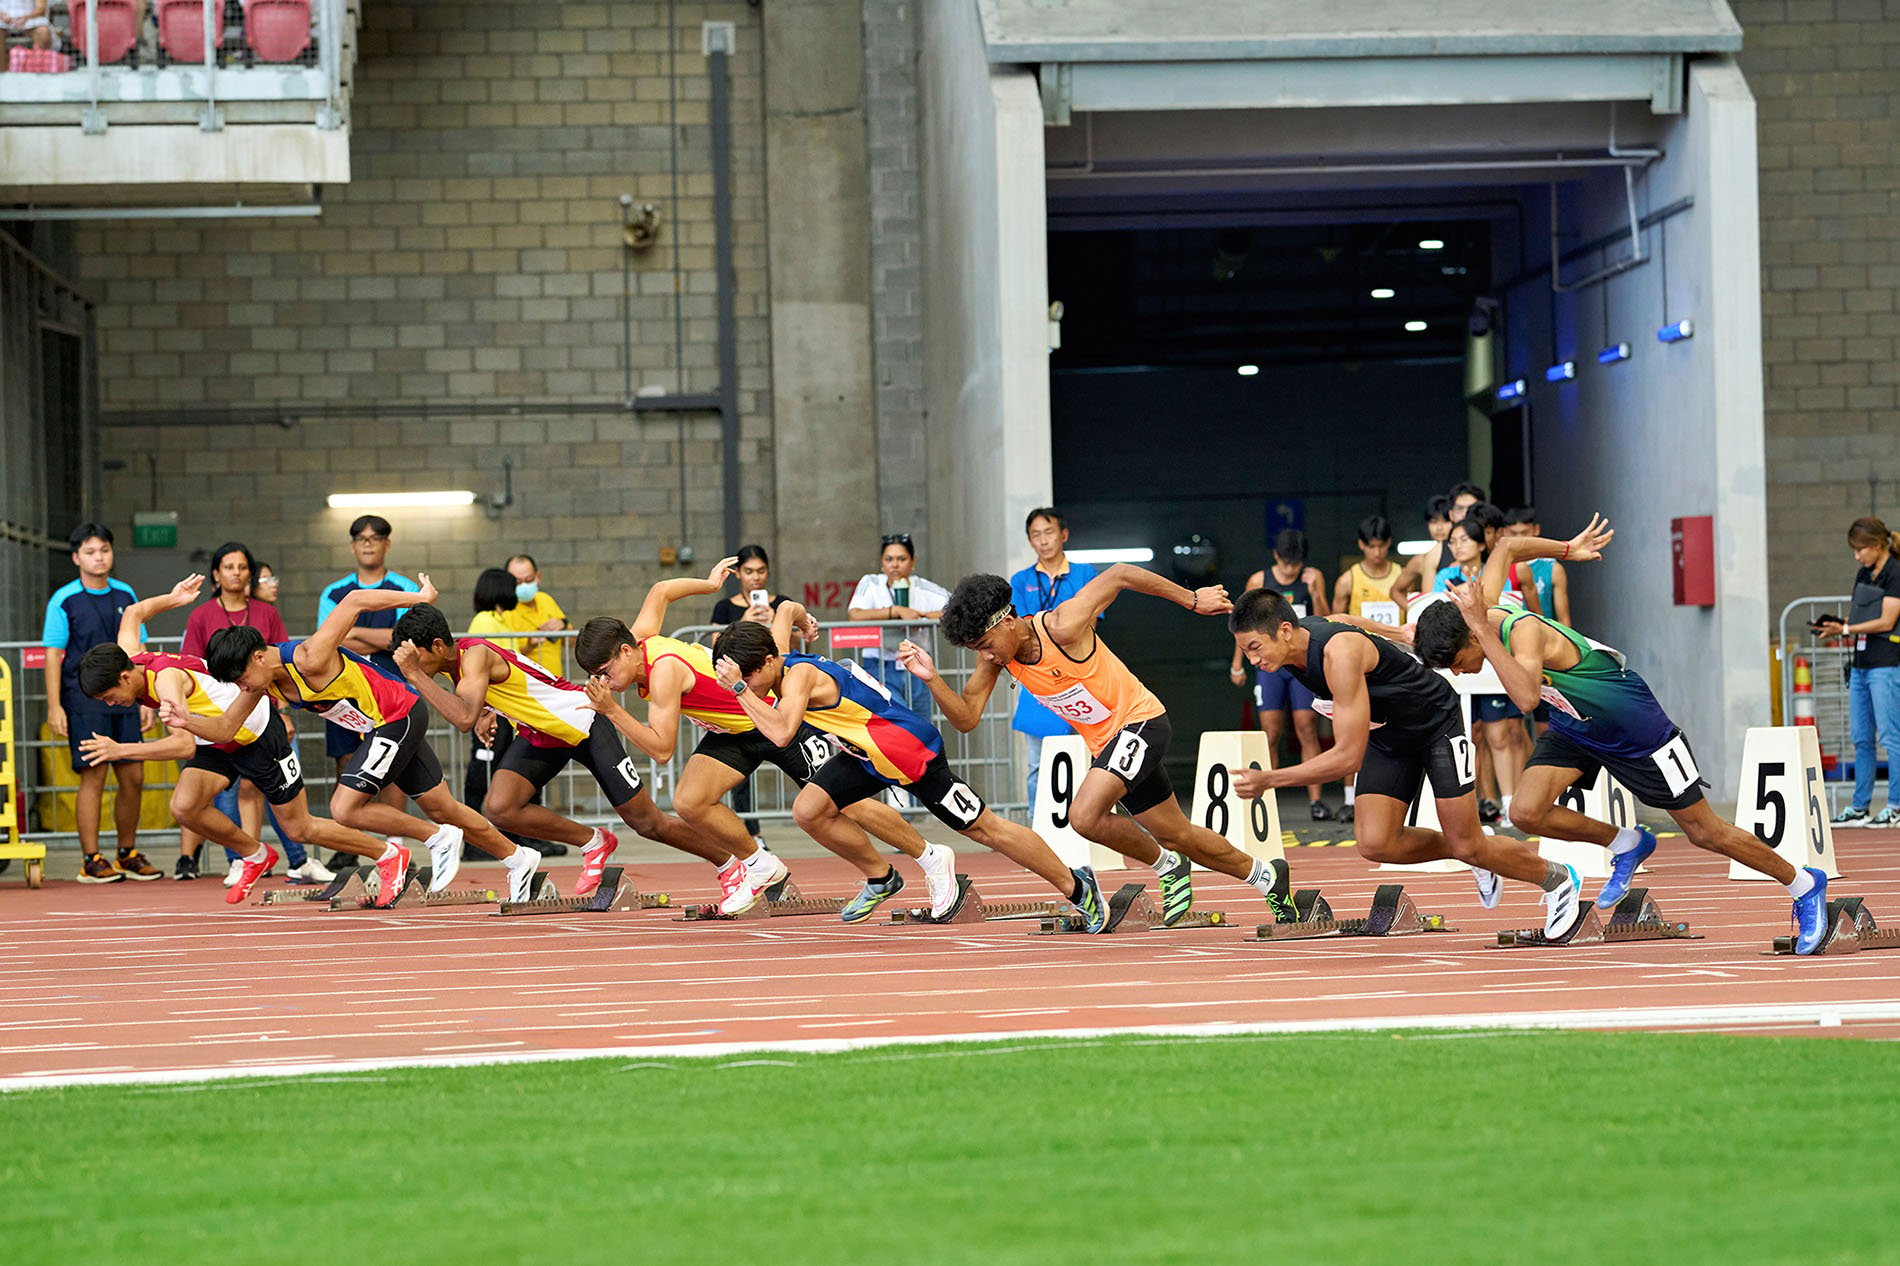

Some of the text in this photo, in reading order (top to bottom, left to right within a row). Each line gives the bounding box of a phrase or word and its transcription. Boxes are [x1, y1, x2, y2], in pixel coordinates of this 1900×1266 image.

[338, 710, 367, 728] 198
[1052, 700, 1093, 717] 753
[370, 741, 392, 771] 7
[813, 739, 825, 759] 5
[1119, 738, 1140, 772] 3
[1459, 739, 1472, 778] 2
[1668, 747, 1689, 782] 1
[287, 758, 297, 777] 8
[625, 761, 637, 781] 6
[953, 789, 976, 814] 4
[1051, 751, 1073, 829] 9
[1205, 763, 1229, 838] 8
[1249, 761, 1269, 842] 8
[1754, 762, 1786, 849] 5
[1806, 766, 1824, 855] 5
